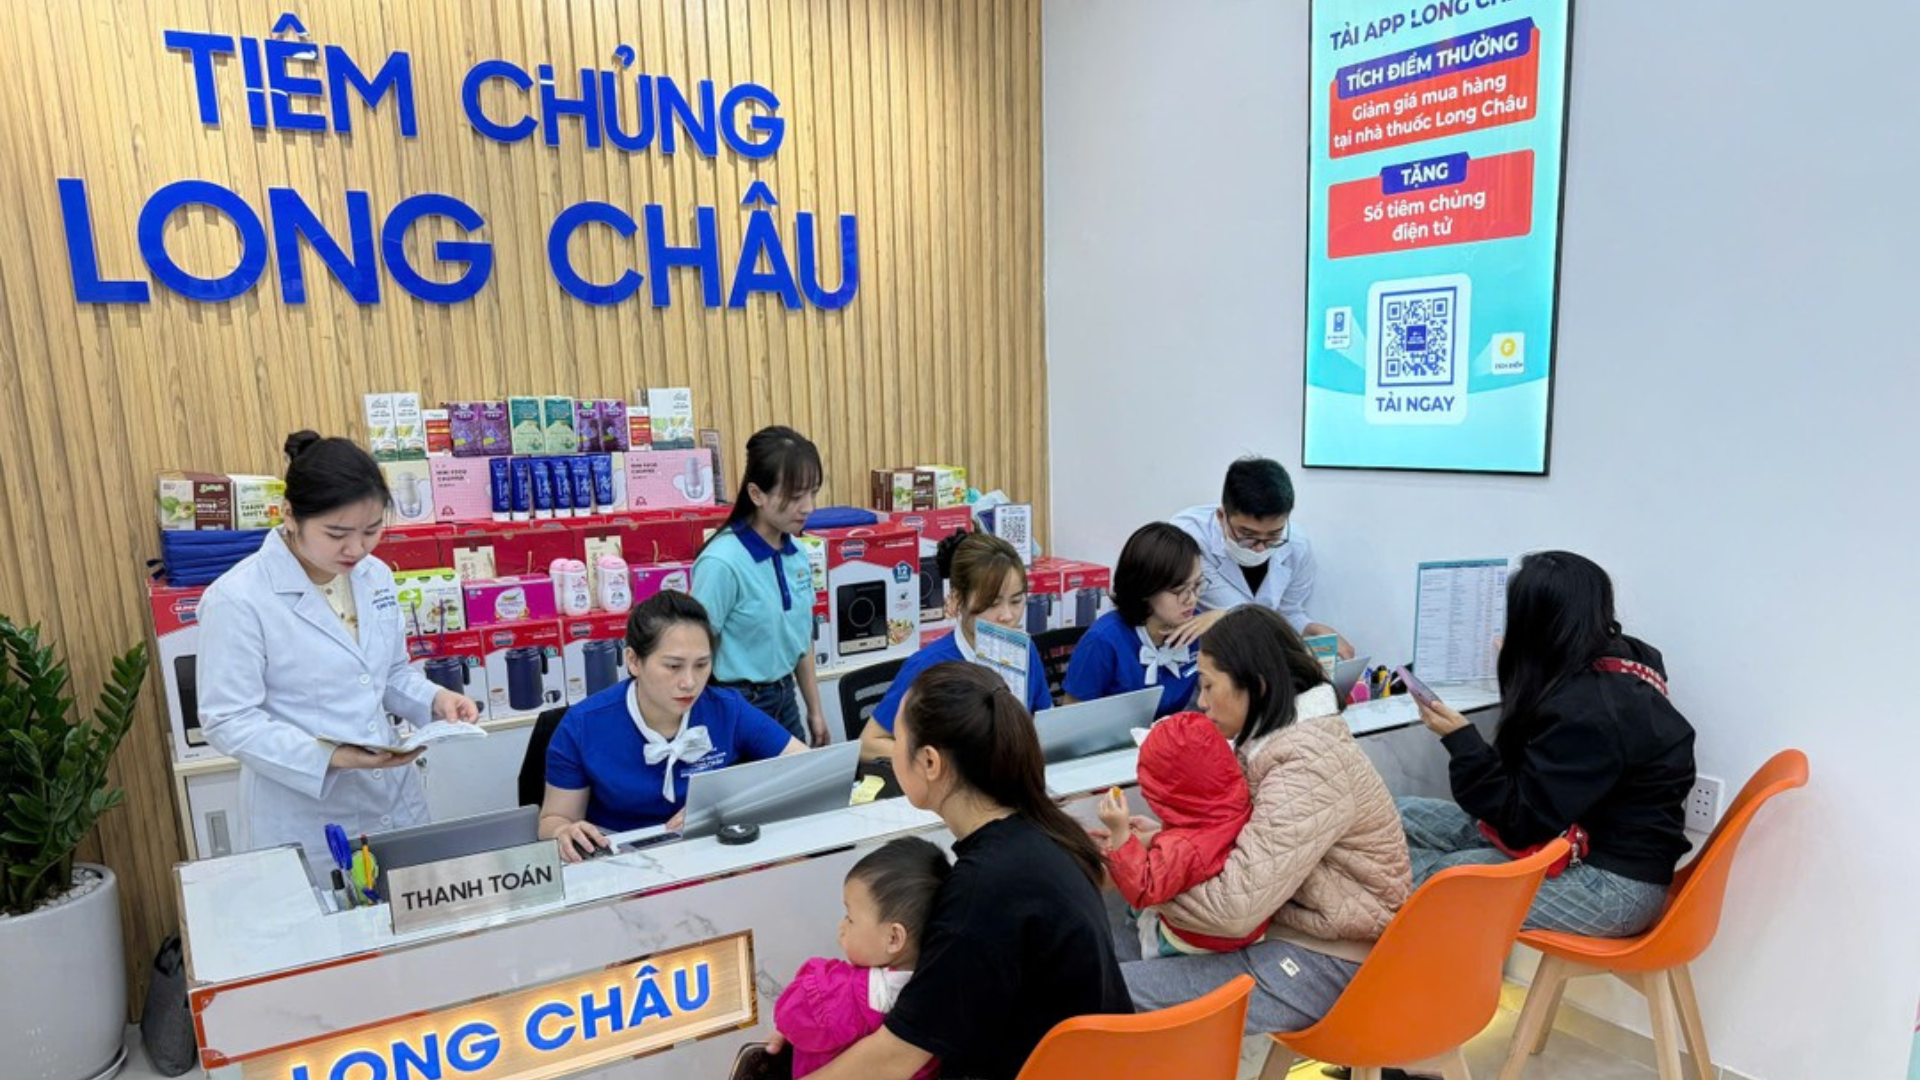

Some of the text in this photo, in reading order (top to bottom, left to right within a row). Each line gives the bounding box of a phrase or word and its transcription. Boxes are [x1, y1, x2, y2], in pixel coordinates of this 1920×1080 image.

[1364, 14, 1405, 42] APP
[1410, 0, 1469, 29] LONG
[1346, 31, 1519, 91] TÍCH ĐIỂM THƯỞNG
[163, 12, 786, 159] TIÊM CHỦNG
[1352, 75, 1507, 121] Giảm giá mua hàng
[1333, 94, 1528, 150] tại nhà thuốc Long Châu
[1401, 162, 1449, 188] TẶNG
[1387, 199, 1425, 219] tiêm
[1428, 189, 1486, 210] chủng
[57, 177, 860, 311] LONG CHÂU
[1392, 221, 1429, 243] điện
[1406, 396, 1455, 412] NGAY
[401, 864, 552, 911] THANH TOÁN
[292, 963, 711, 1080] ONG CHÂU
